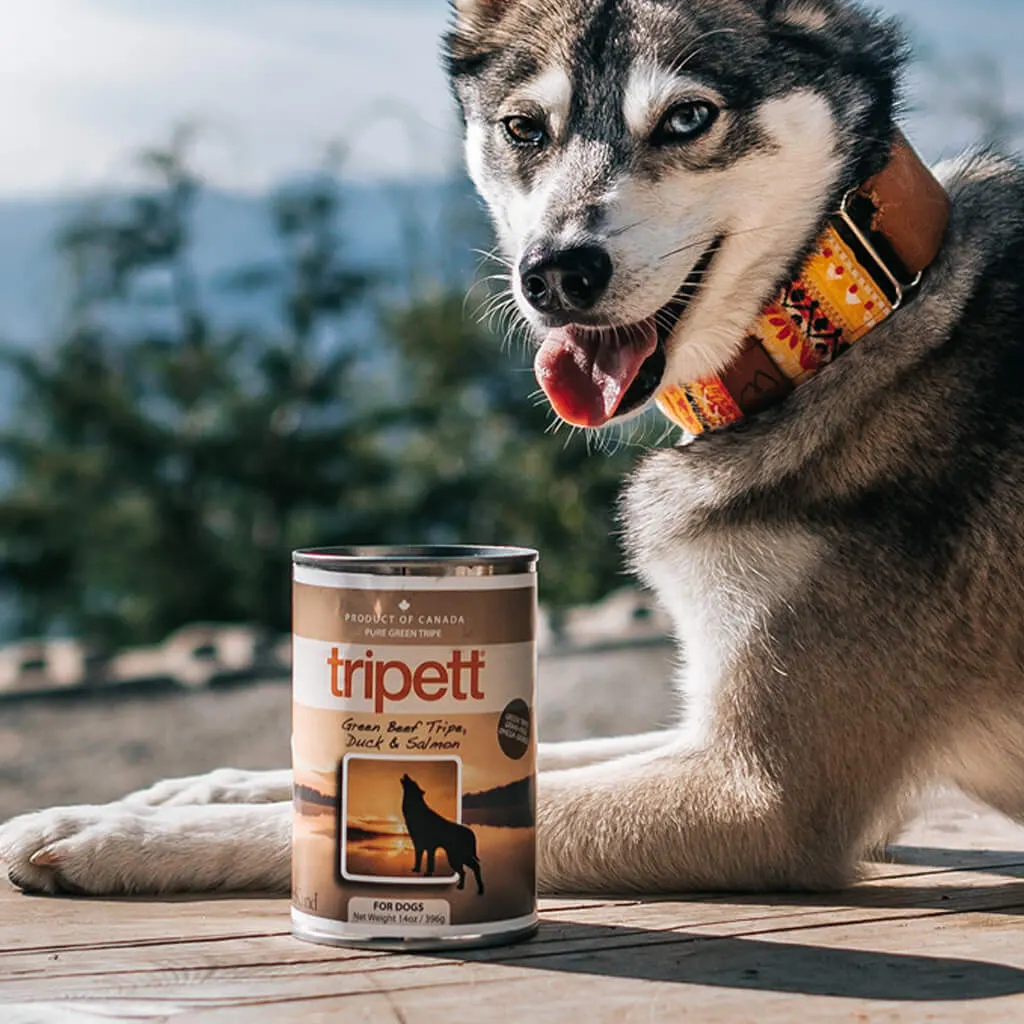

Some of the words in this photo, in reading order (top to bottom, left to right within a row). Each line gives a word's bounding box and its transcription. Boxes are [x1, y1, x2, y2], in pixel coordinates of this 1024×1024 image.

[344, 613, 395, 624] PRODUCT
[400, 615, 414, 624] OF
[418, 615, 465, 624] CANADA
[364, 628, 386, 637] PURE
[388, 629, 417, 637] GREEN
[419, 629, 442, 637] TRIPE
[341, 717, 380, 732] Green
[387, 720, 422, 734] Beef
[345, 733, 384, 750] Duck
[389, 737, 400, 749] &
[406, 736, 461, 750] Salmon
[373, 901, 393, 911] FOR
[395, 902, 424, 912] DOGS
[353, 912, 366, 922] Net
[368, 913, 397, 925] Weight
